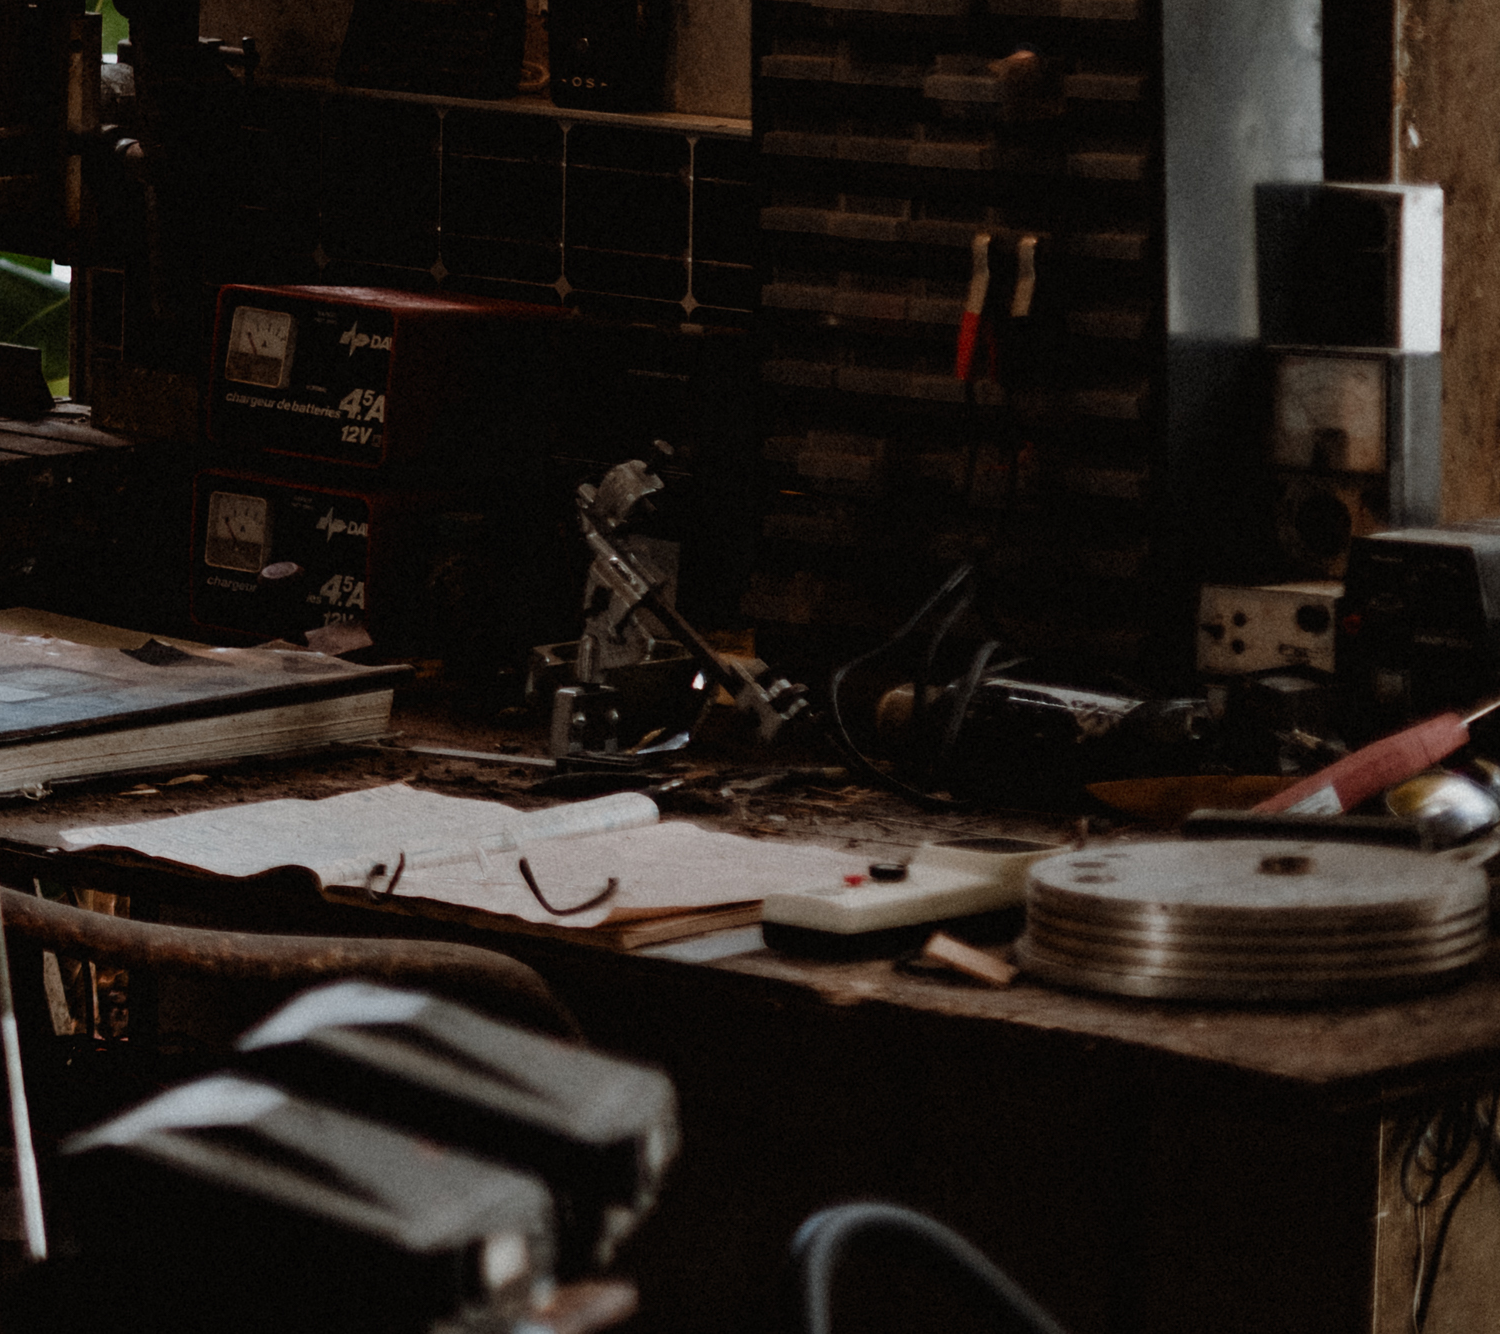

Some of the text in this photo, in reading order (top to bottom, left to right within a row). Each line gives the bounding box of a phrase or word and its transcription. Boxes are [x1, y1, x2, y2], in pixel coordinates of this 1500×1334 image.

[369, 334, 393, 352] DA
[225, 391, 276, 409] chargeur
[276, 397, 291, 411] de
[291, 399, 342, 420] batteries
[341, 425, 373, 445] 12V
[346, 520, 369, 538] DA
[206, 575, 258, 593] chargeur
